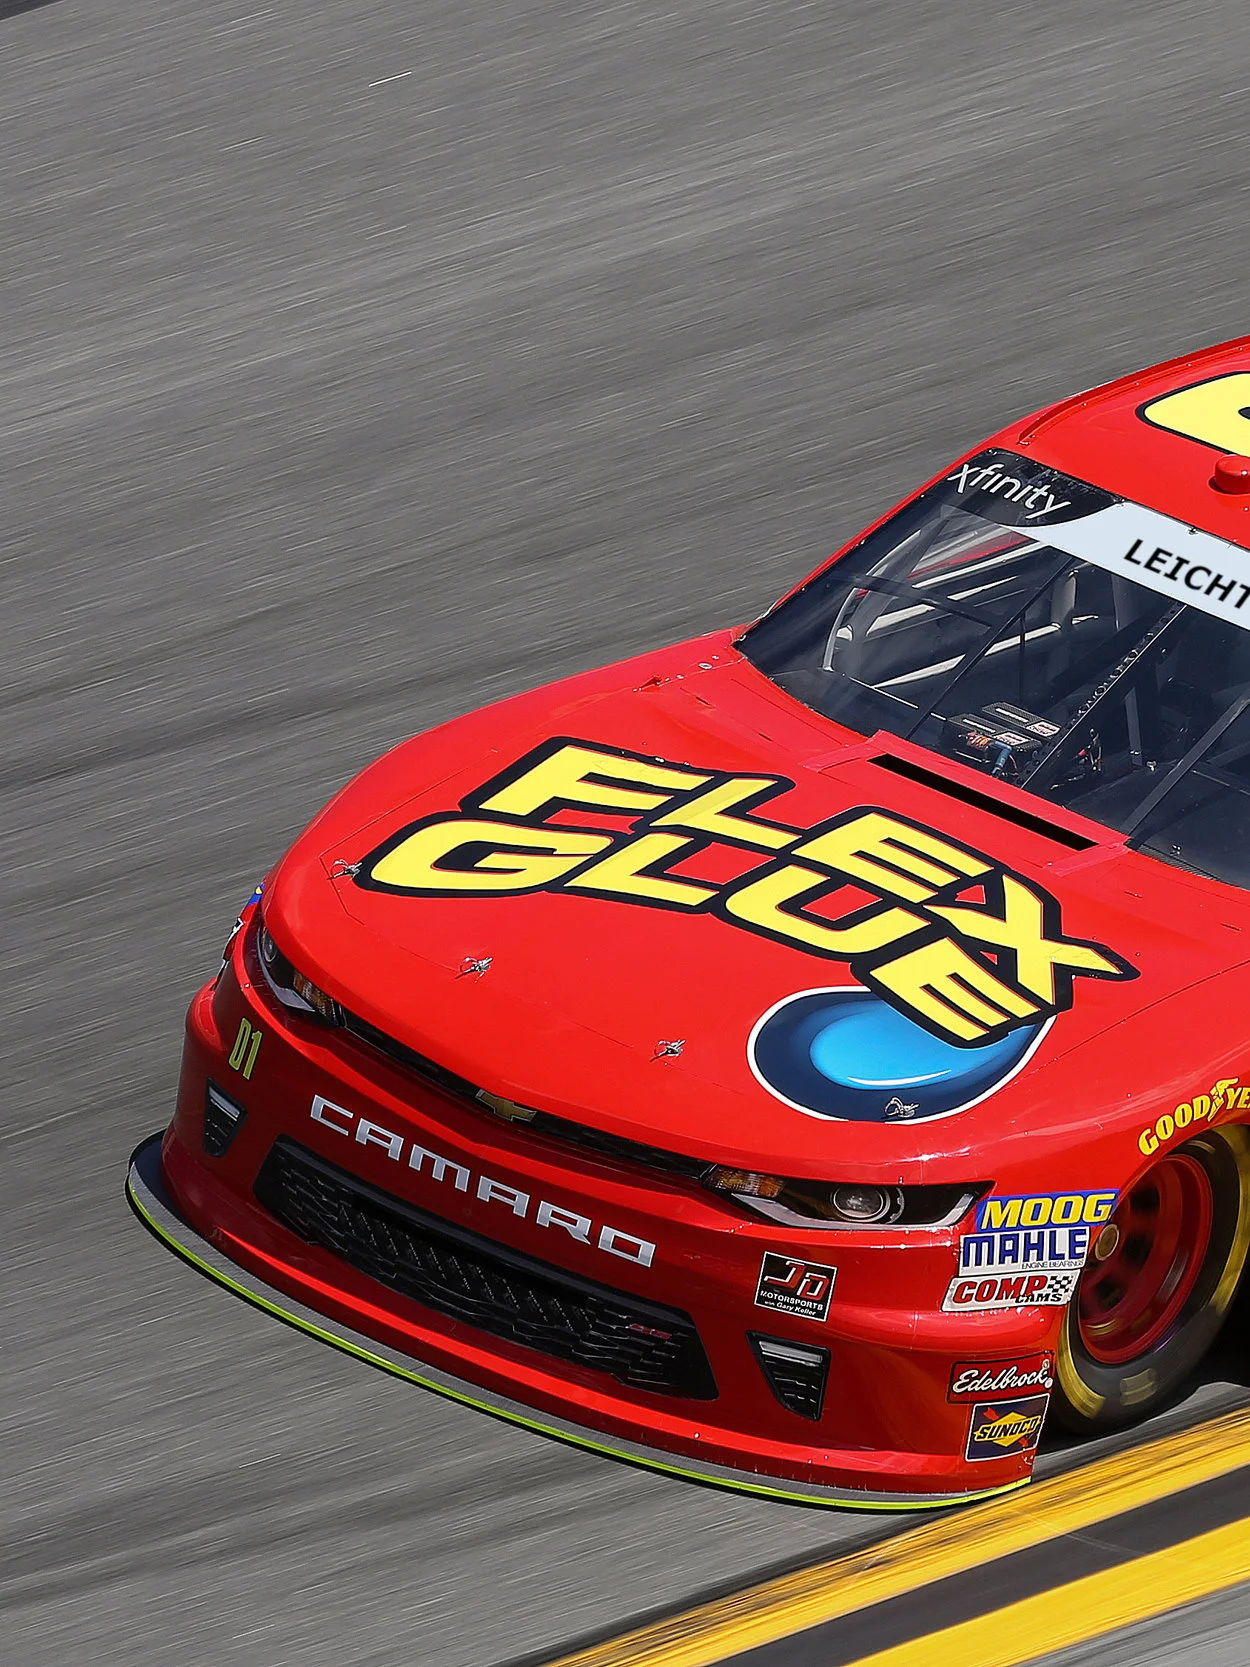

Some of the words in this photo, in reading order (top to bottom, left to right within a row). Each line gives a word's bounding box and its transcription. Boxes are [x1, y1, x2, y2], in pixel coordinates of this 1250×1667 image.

[946, 463, 1072, 520] xfinity
[475, 742, 1128, 1007] FLEX
[366, 818, 1045, 1042] GLUE
[228, 1017, 263, 1080] 01
[310, 1094, 657, 1268] CAMARO
[981, 1193, 1116, 1230] MOOG
[962, 1229, 1087, 1267] MAHLE
[1022, 1261, 1048, 1270] ENGINE
[760, 1290, 824, 1311] MOTORSPORTS
[953, 1275, 1048, 1304] COMP
[1015, 1293, 1063, 1303] CAMS
[776, 1302, 794, 1312] Gary
[952, 1362, 1049, 1393] Edelbrock
[977, 1418, 1039, 1440] SUNOCO
